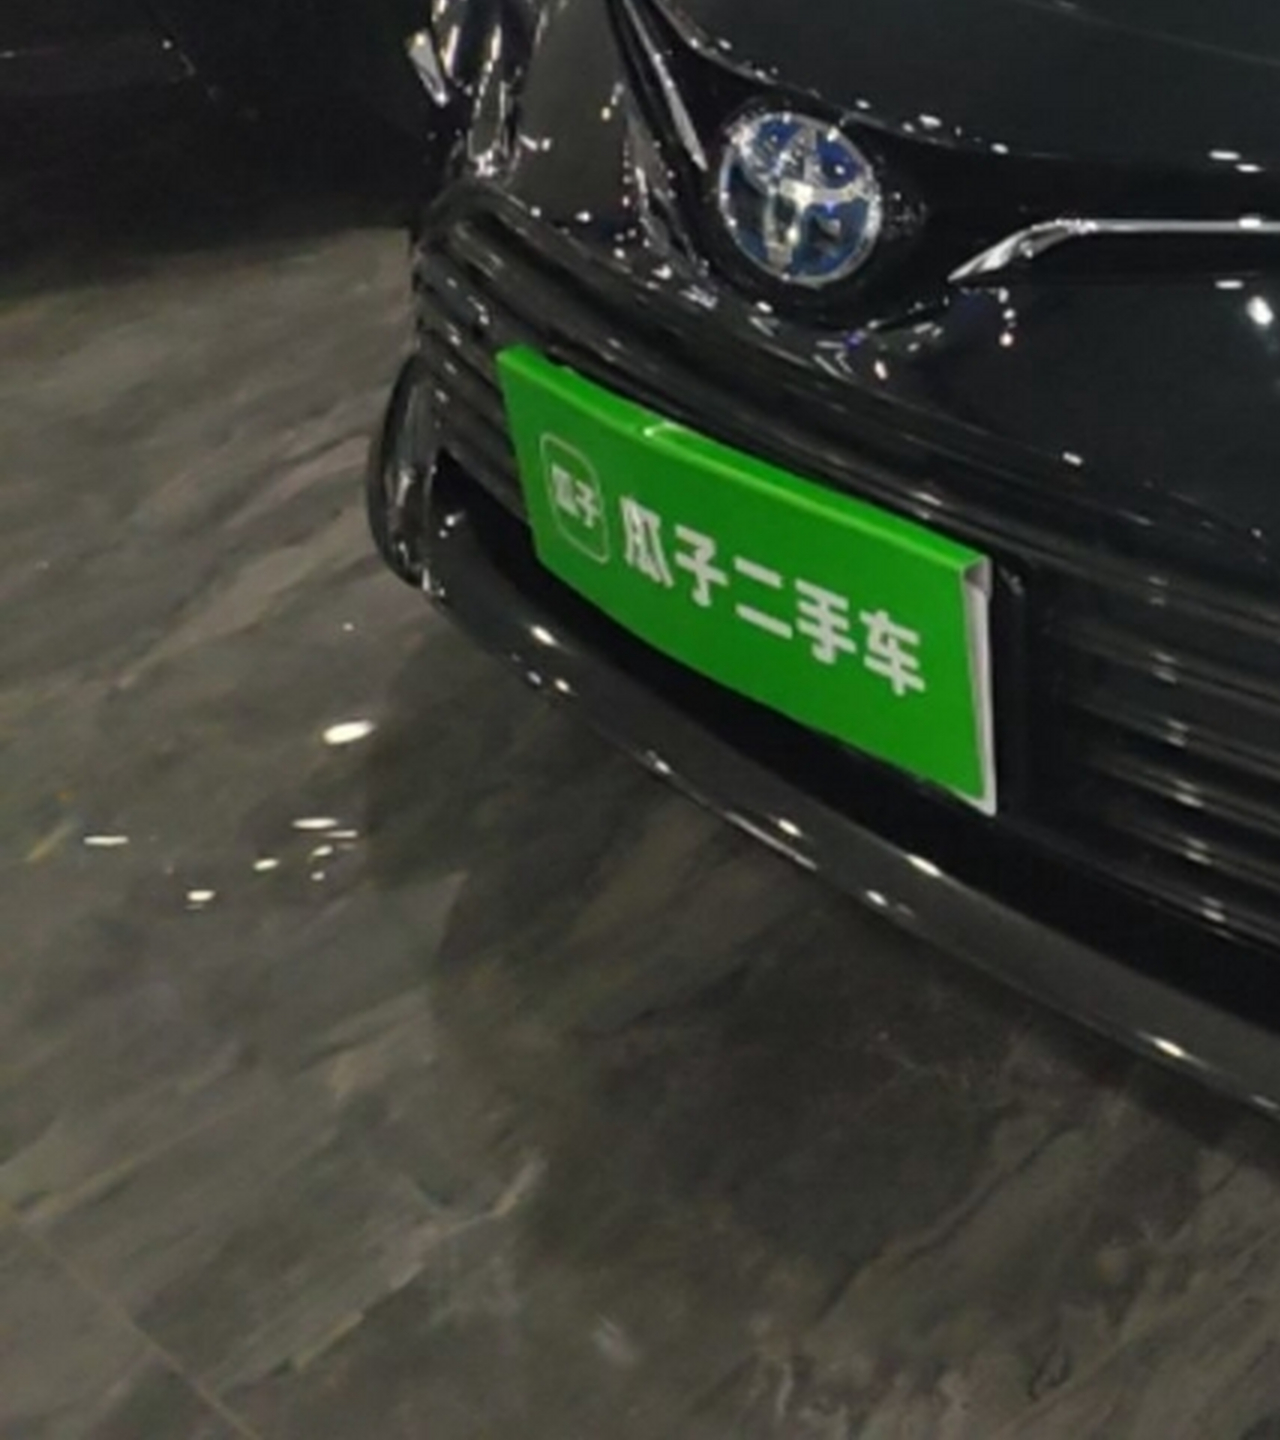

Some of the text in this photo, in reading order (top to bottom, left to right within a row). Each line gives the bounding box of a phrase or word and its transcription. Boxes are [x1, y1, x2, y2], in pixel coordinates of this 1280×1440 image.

[619, 496, 926, 696] 瓜子二手车
